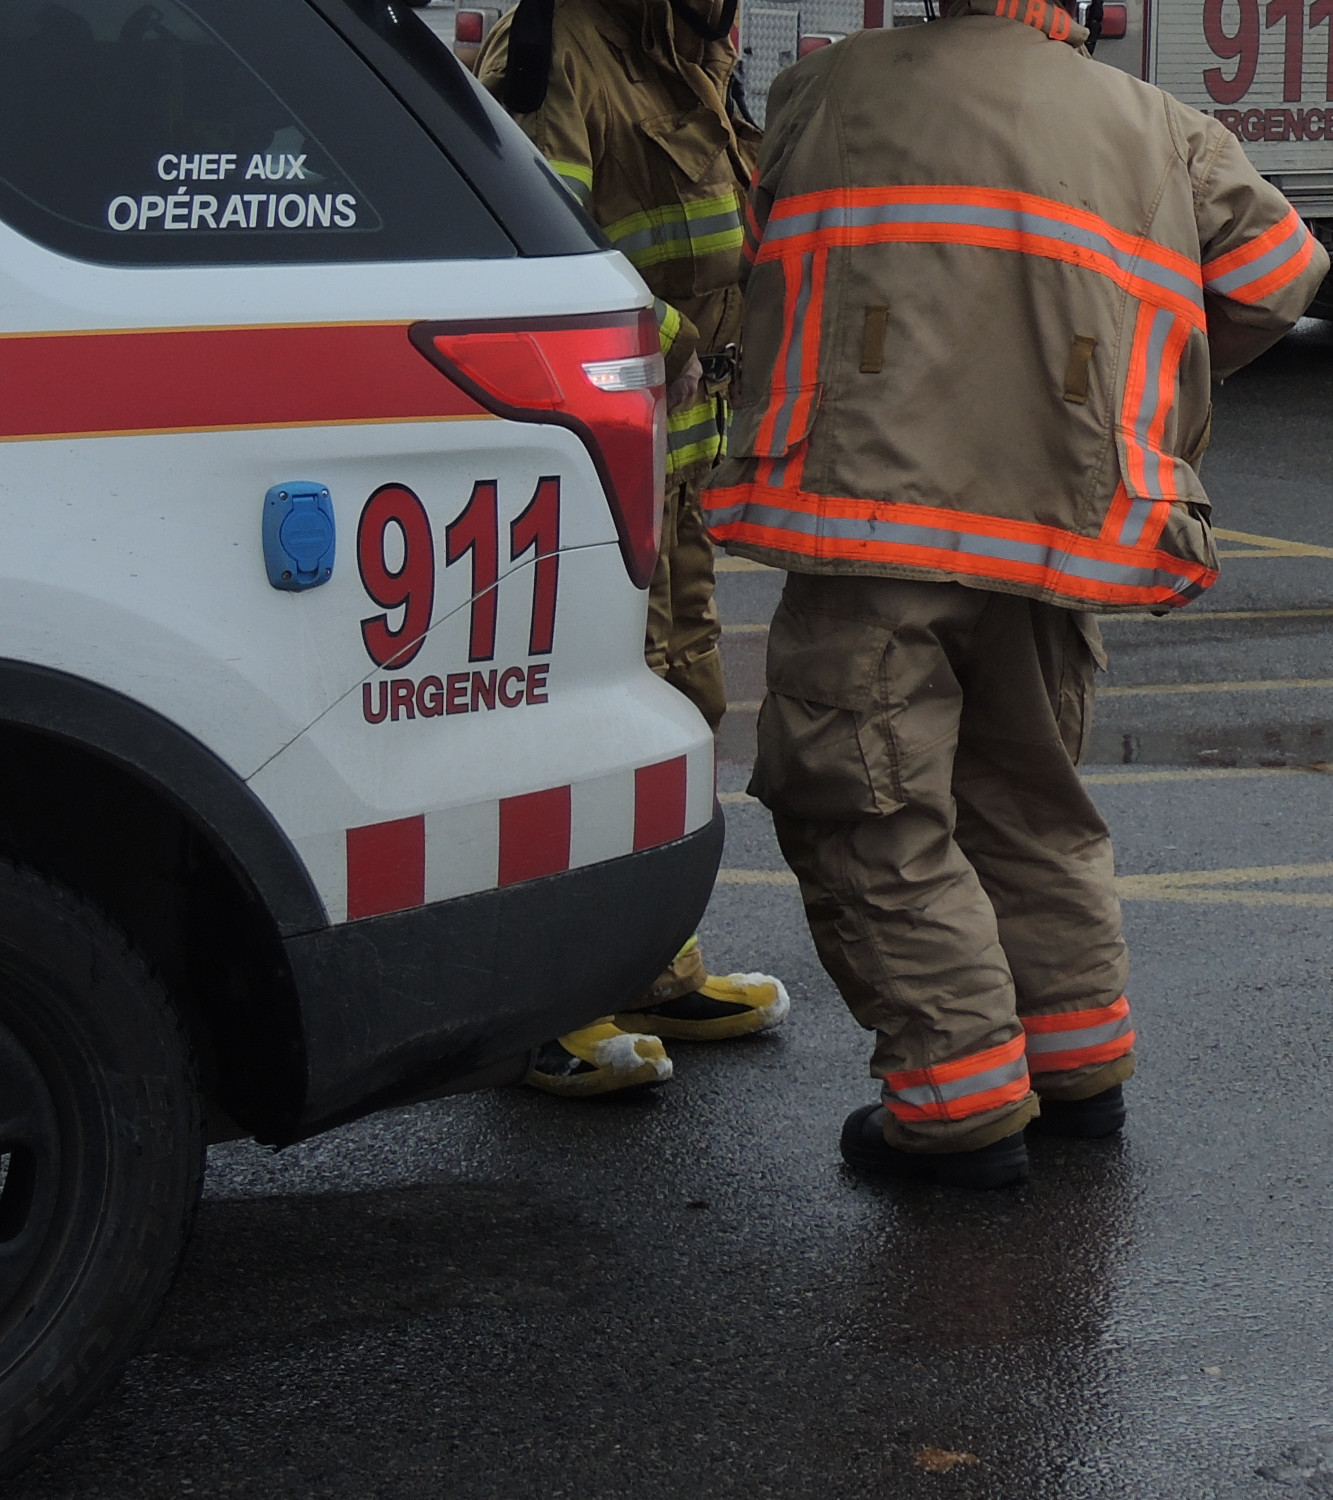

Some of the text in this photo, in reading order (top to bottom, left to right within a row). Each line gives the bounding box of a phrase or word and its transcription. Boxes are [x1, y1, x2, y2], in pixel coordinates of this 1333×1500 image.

[157, 153, 308, 181] CHEF AUX
[107, 185, 358, 232] OPÉRATIONS
[356, 474, 561, 671] 911
[362, 663, 550, 725] URGENCE
